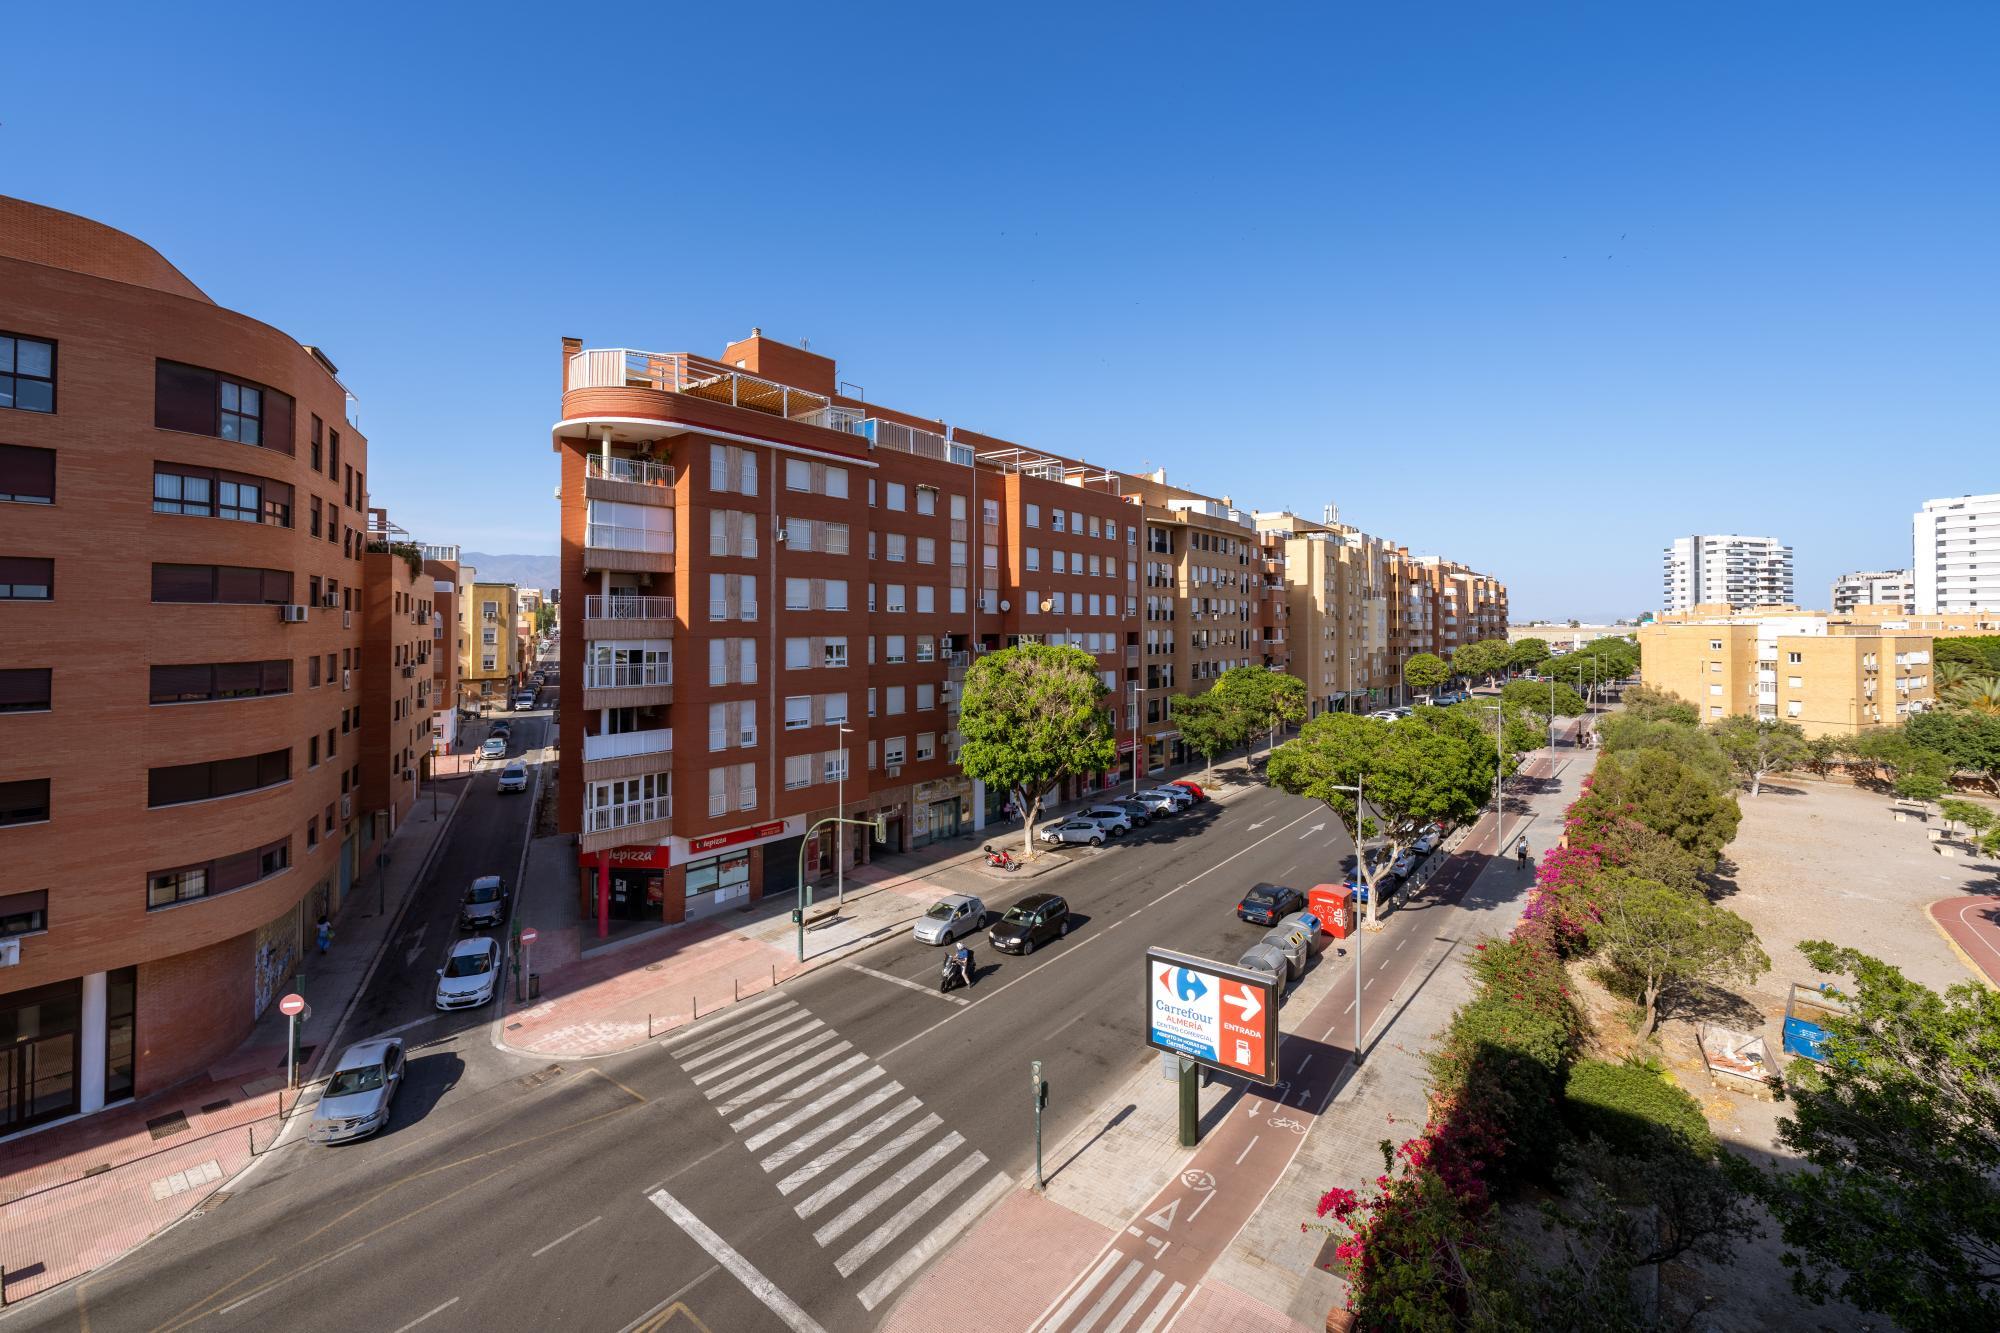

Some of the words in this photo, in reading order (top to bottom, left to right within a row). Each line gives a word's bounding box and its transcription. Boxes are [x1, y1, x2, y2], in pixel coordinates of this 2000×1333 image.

[1156, 1000, 1213, 1024] Carrefour
[1157, 1021, 1178, 1033] CENTRO
[1179, 1028, 1214, 1042] COMERCIAL
[1167, 1015, 1203, 1031] ALMERÍA
[1223, 1022, 1262, 1039] ENTRADA
